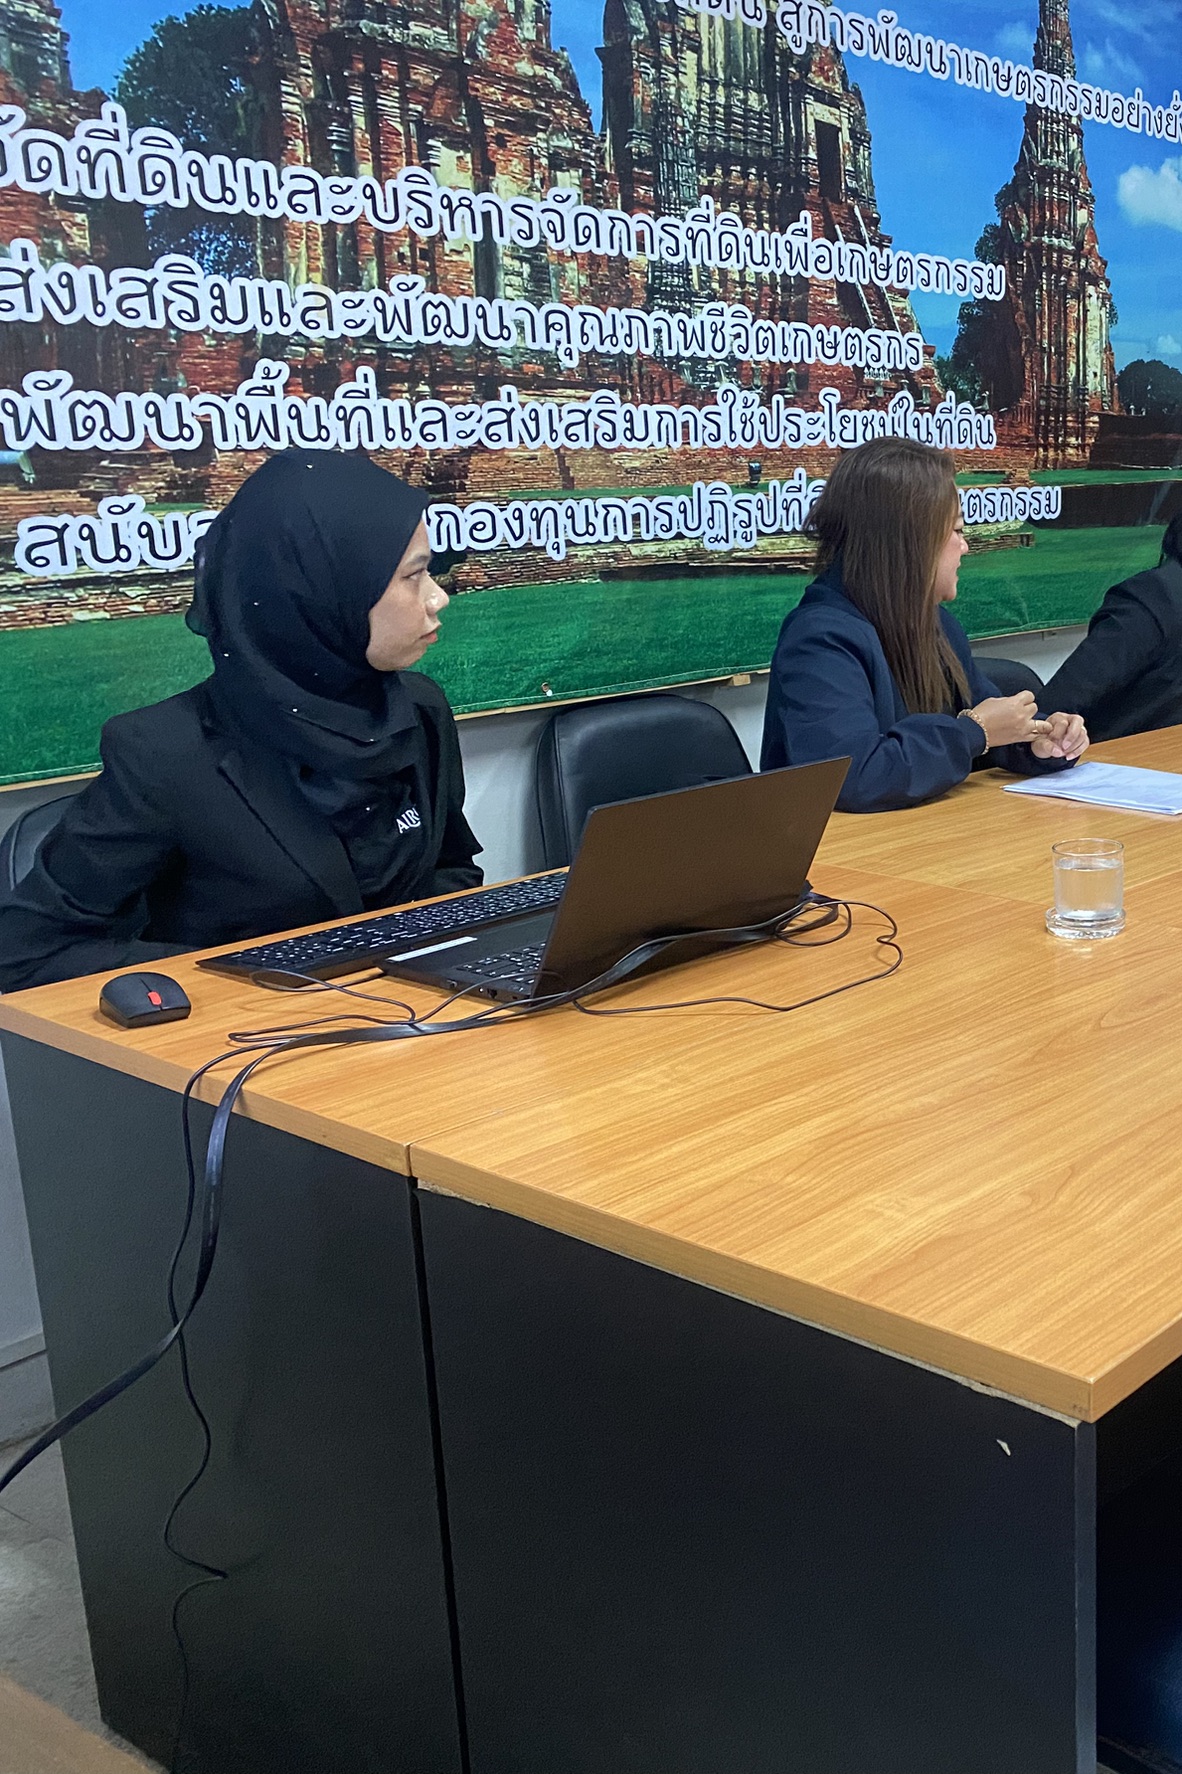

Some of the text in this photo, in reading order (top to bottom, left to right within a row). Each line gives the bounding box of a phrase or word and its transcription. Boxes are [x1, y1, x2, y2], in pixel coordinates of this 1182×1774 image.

[0, 108, 1004, 297] ัดที่ดินและบริหารจัดการที่ดินเพื่อเกษตรกรรม
[25, 502, 215, 568] สนับ
[959, 490, 1059, 521] ตรกรรม
